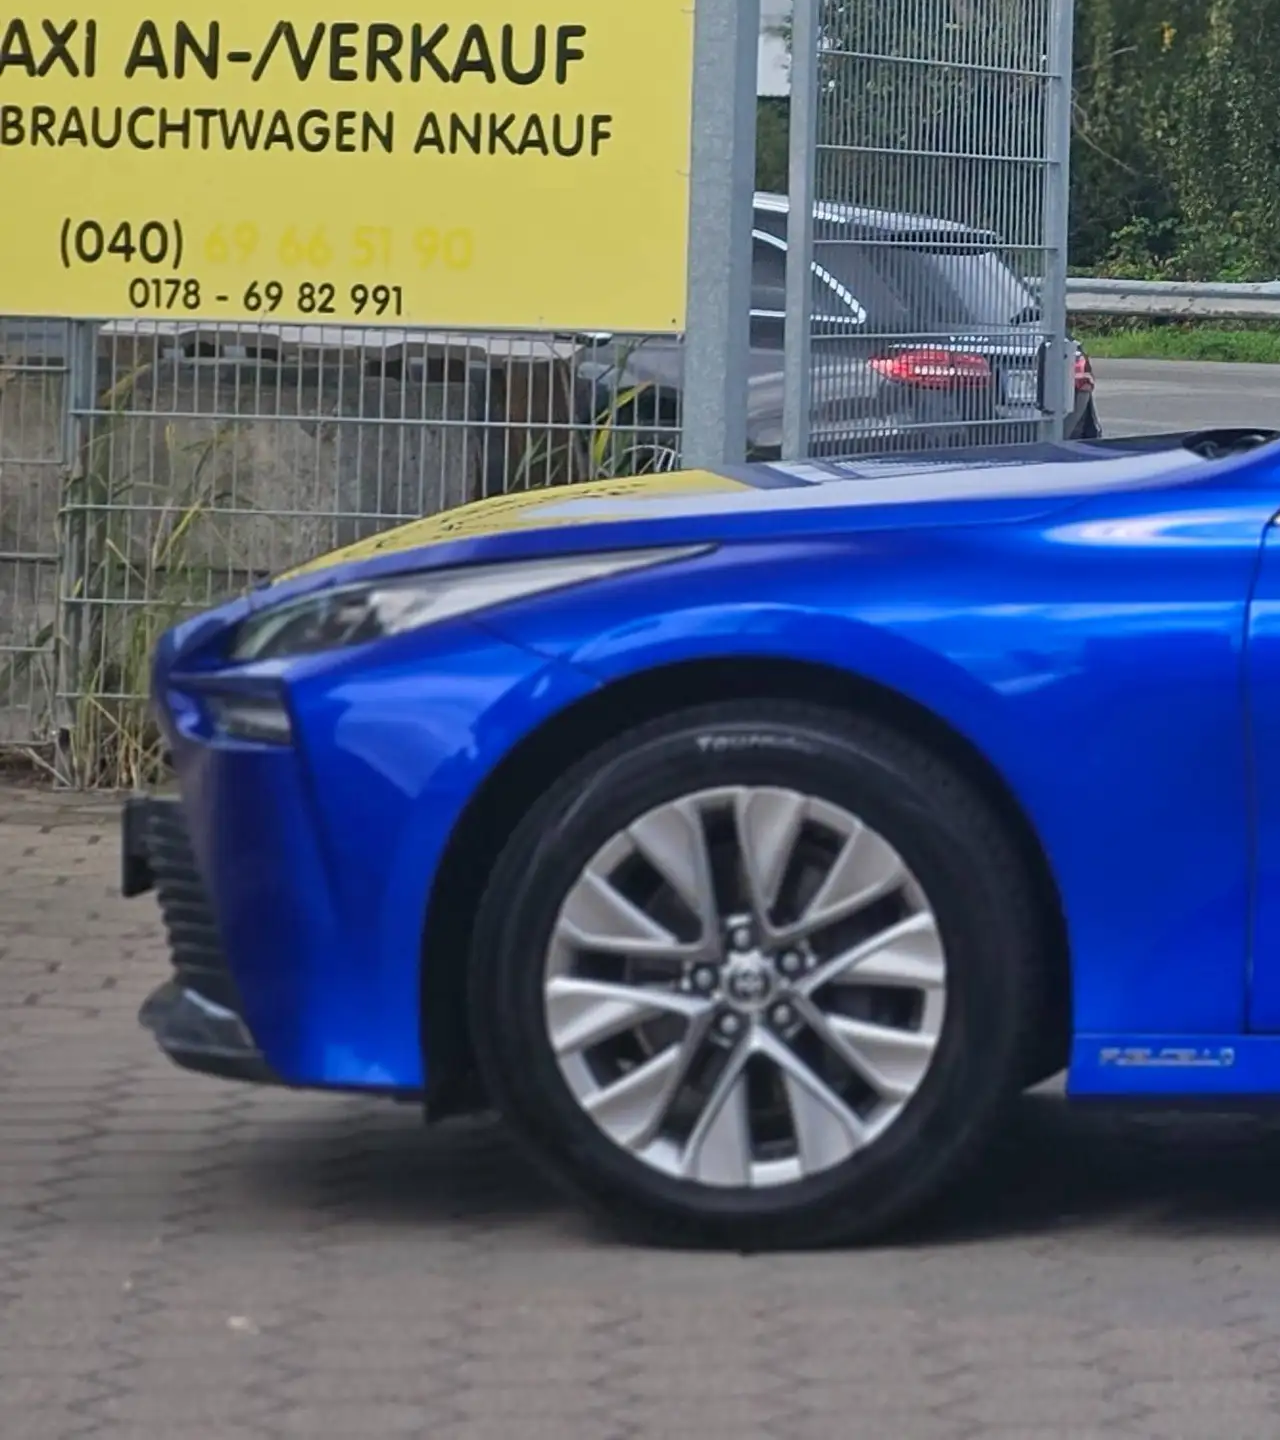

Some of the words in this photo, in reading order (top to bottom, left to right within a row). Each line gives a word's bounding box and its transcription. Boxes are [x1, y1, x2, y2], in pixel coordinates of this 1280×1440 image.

[125, 20, 587, 86] AN-/VERKAUF
[414, 112, 613, 157] ANKAUF
[60, 217, 183, 270] (040)
[203, 220, 259, 264] 69
[277, 222, 333, 269] 66
[351, 225, 392, 270] 51
[411, 226, 473, 271] 90
[129, 277, 201, 310] 0178
[243, 280, 283, 312] 69
[297, 281, 336, 315] 82
[350, 283, 402, 316] 991
